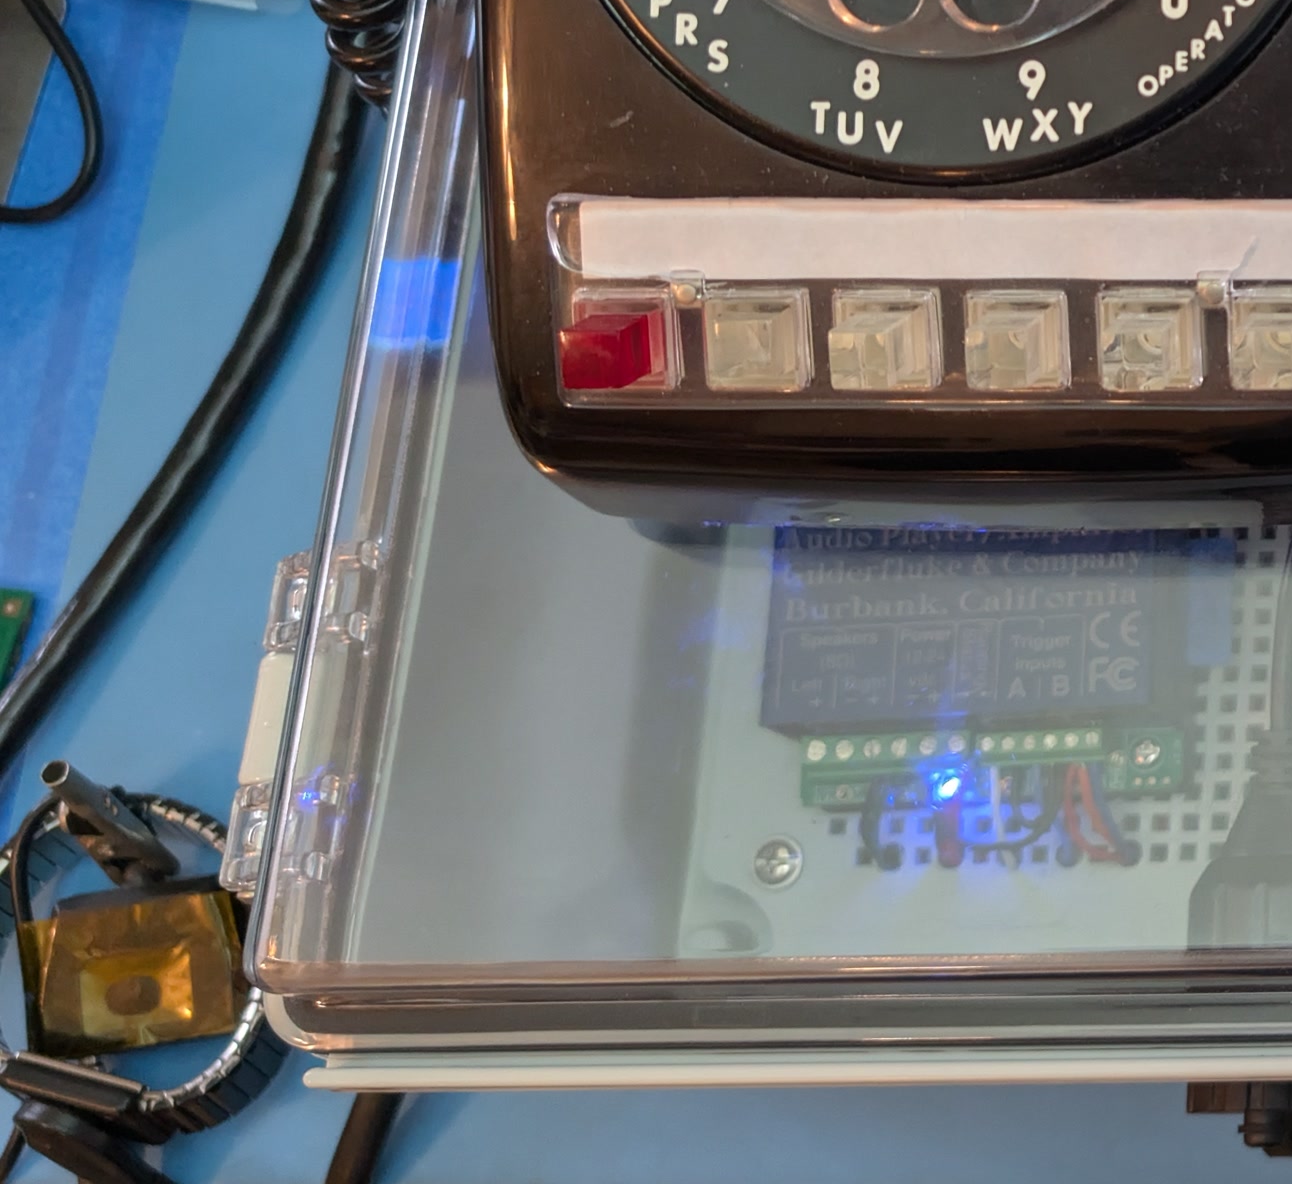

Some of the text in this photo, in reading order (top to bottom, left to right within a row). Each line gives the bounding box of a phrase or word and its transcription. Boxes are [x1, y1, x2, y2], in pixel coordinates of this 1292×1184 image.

[852, 57, 881, 101] 8
[1017, 58, 1047, 102] 9
[810, 100, 903, 154] TUV
[981, 101, 1094, 152] WXY
[959, 581, 1137, 613] California
